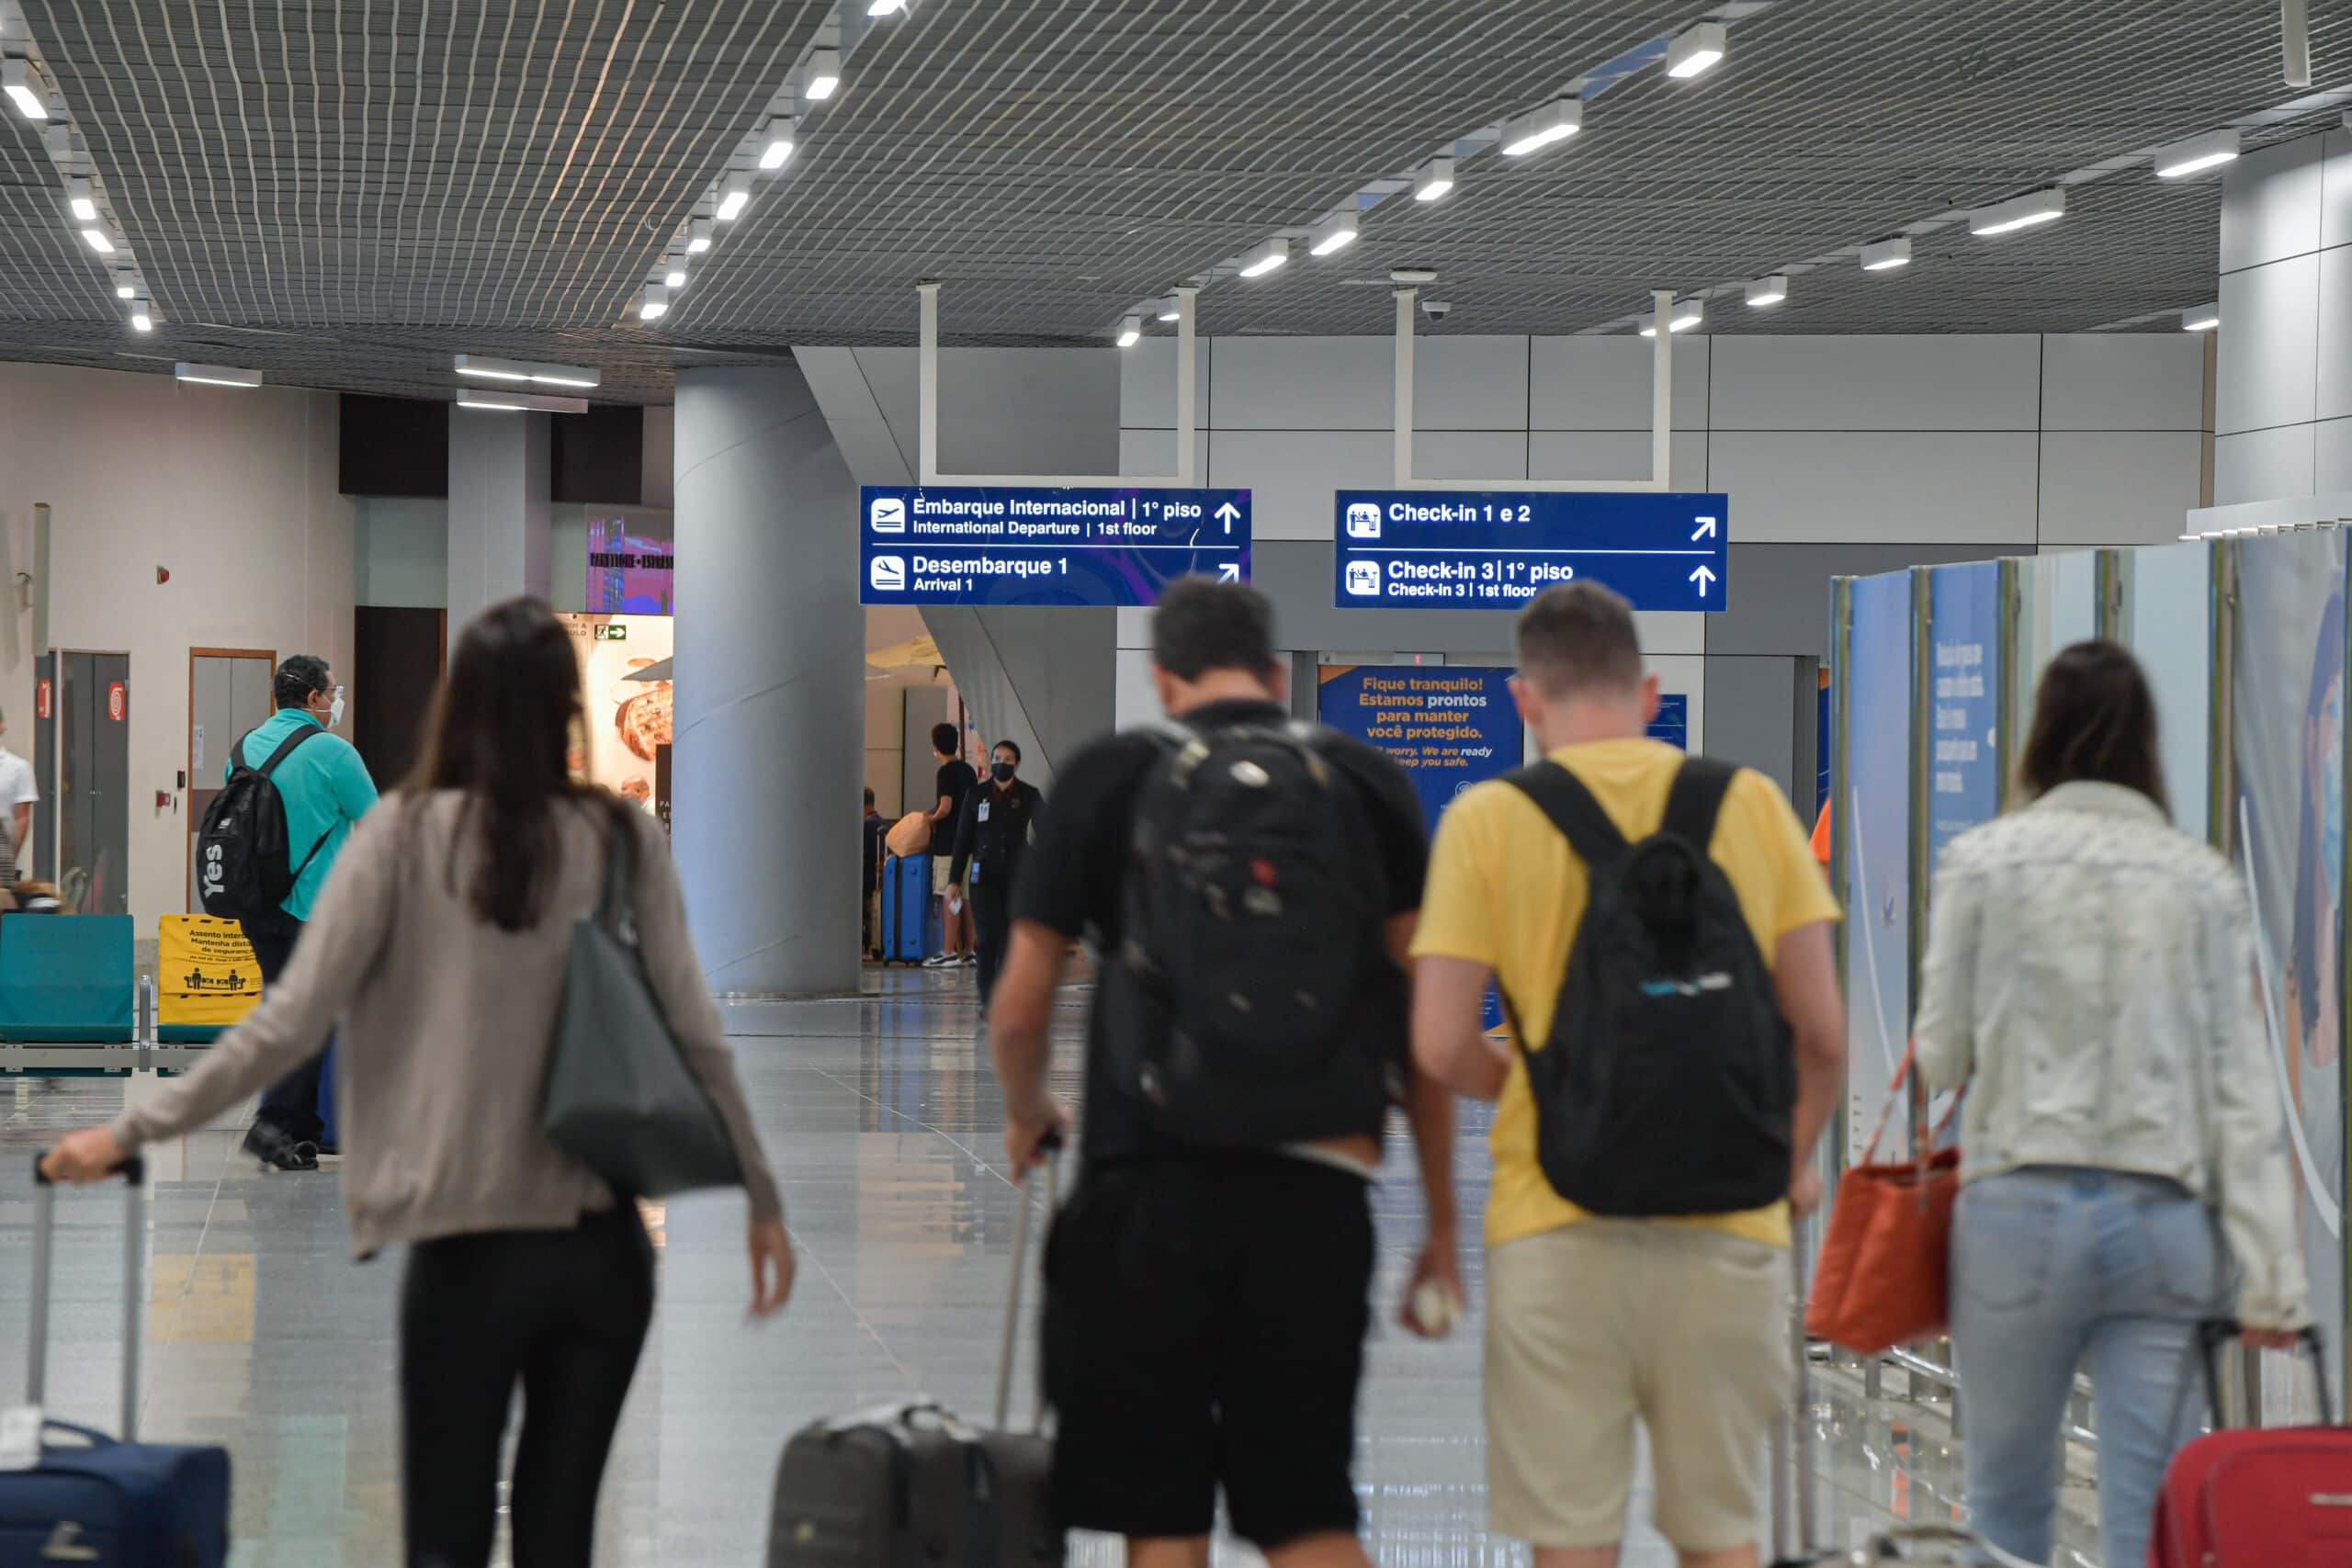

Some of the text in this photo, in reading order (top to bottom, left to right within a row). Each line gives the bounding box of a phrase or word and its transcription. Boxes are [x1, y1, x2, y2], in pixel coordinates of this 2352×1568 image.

[913, 499, 1005, 519] Embarque
[1010, 499, 1125, 515] Internacional
[1163, 502, 1202, 521] piso
[1388, 502, 1531, 522] Check-in 1 e 2
[913, 520, 1004, 534] International
[1008, 521, 1080, 537] Departure
[1097, 522, 1120, 535] 1st
[1123, 522, 1158, 536] floor
[912, 556, 1068, 579] Desembarque 1
[1388, 560, 1476, 580] Check-in
[1481, 562, 1494, 580] 3
[1530, 562, 1574, 584] piso
[913, 578, 973, 592] Arrival 1
[1388, 582, 1453, 596] Check-in
[1455, 583, 1465, 596] 3
[1477, 584, 1499, 597] 1st
[1502, 584, 1537, 597] floor
[1363, 677, 1484, 693] Fique tranquilo!
[1360, 693, 1487, 708] Estamos prontos
[1376, 711, 1469, 724] para manter
[1367, 724, 1483, 740] você protegido.
[1421, 747, 1440, 756] We
[1441, 748, 1459, 756] are
[1460, 746, 1493, 758] ready
[1421, 759, 1442, 768] you
[1443, 758, 1469, 768] safe.
[203, 844, 224, 898] Yes
[189, 929, 221, 939] Assento
[190, 938, 231, 947] Mantenha
